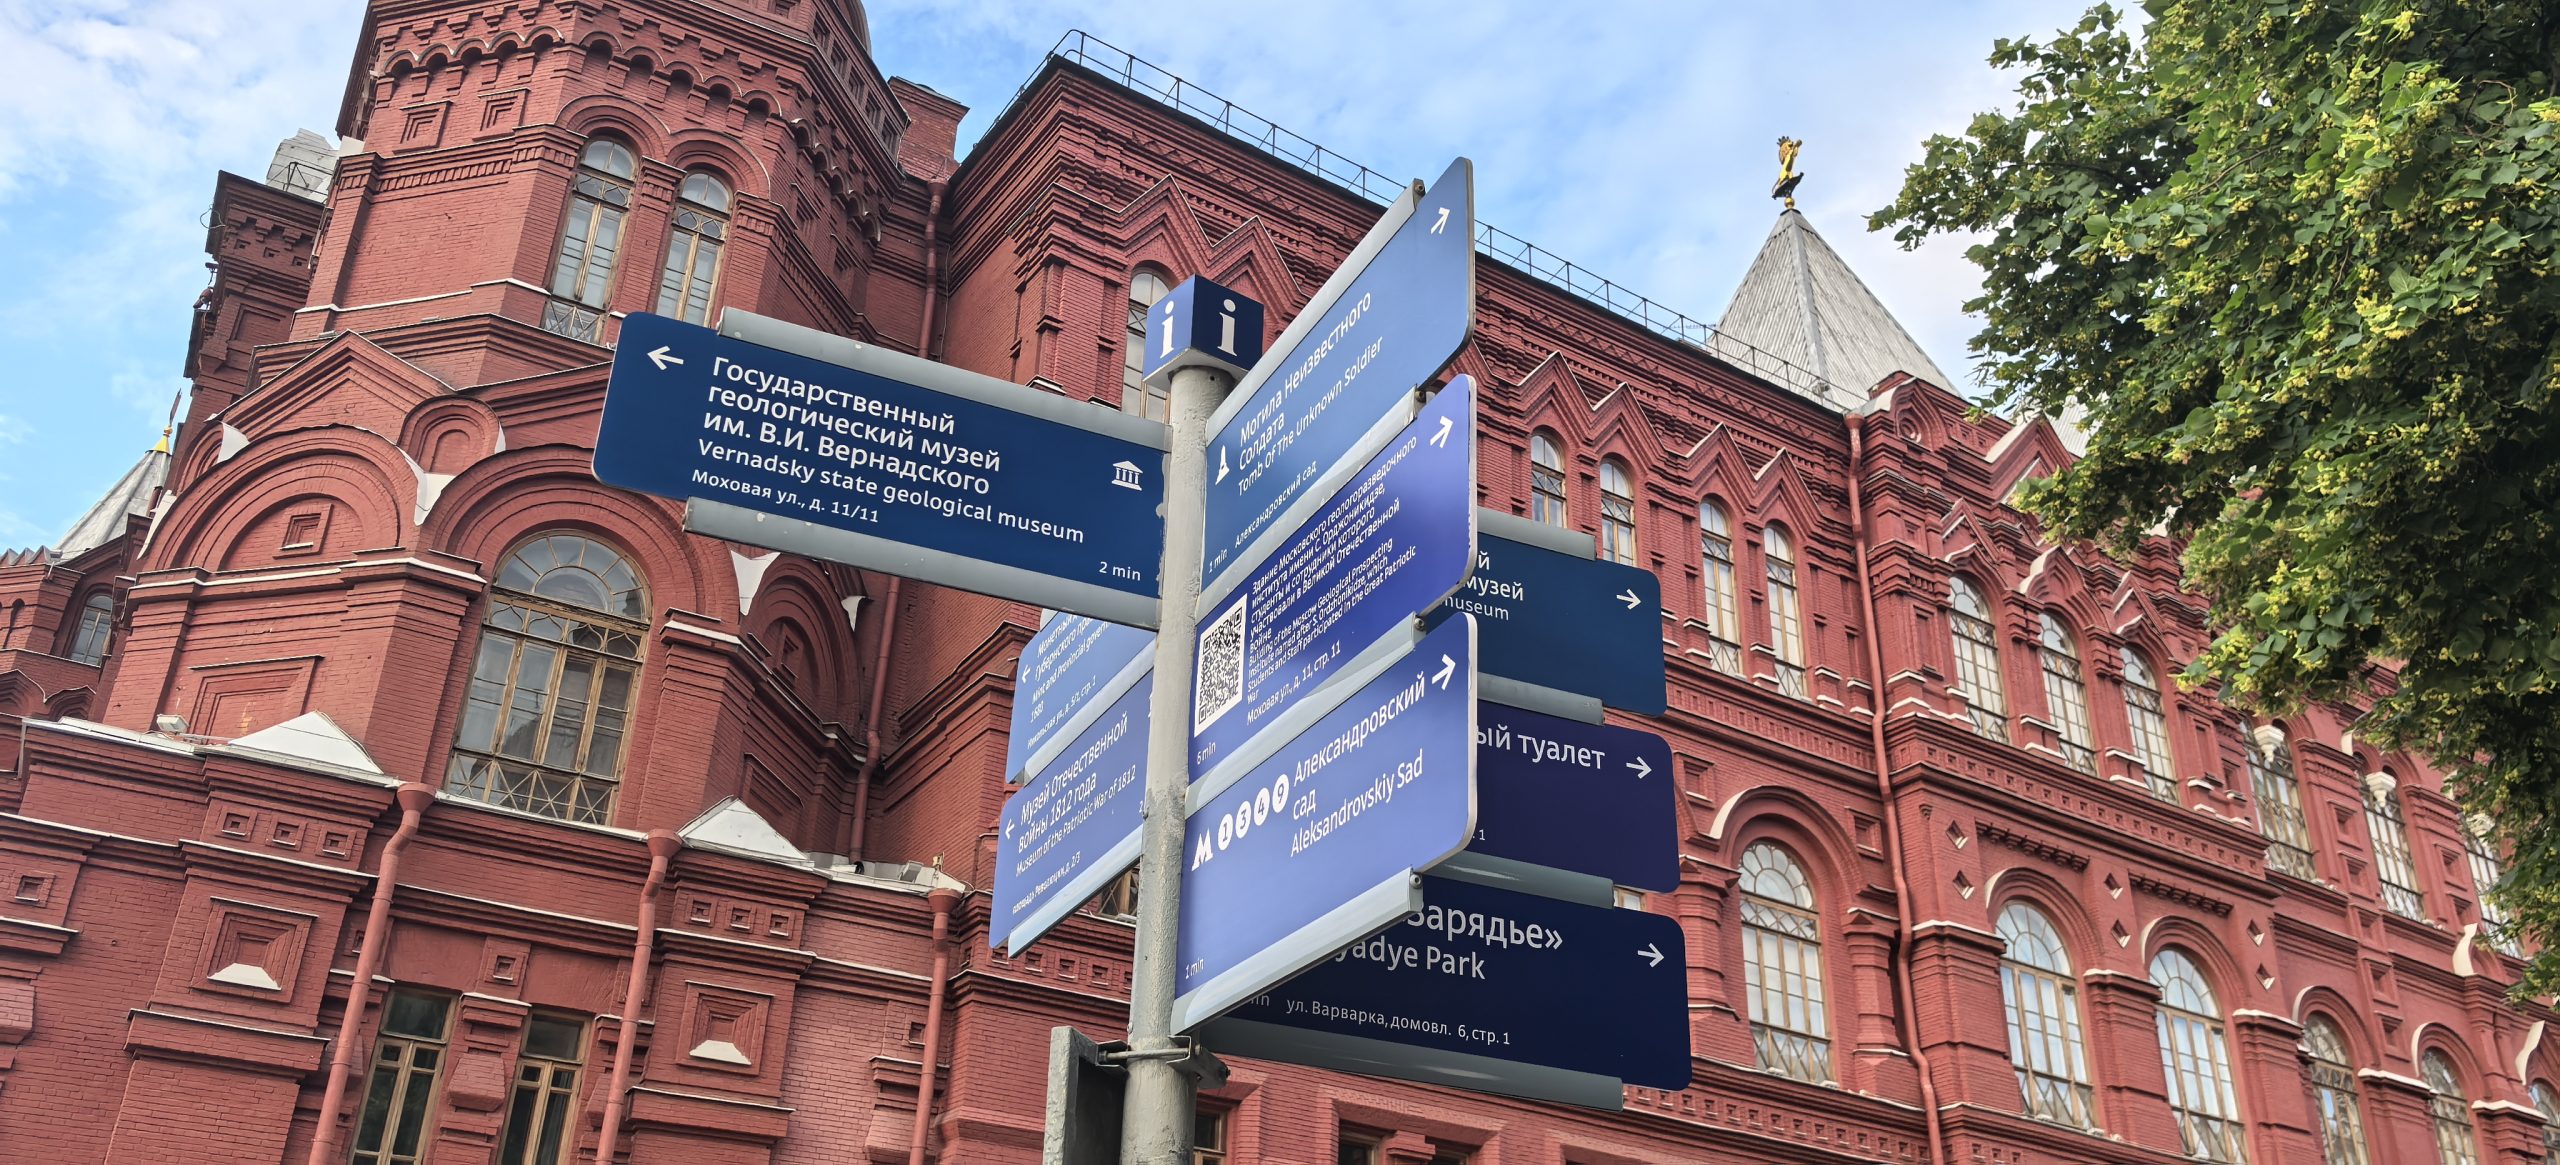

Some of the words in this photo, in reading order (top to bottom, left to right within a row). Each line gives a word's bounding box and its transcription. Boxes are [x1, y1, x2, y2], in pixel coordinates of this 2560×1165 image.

[713, 357, 955, 435] Государственный
[1240, 390, 1282, 447] Могила
[1285, 292, 1371, 399] Неизвестного
[703, 412, 751, 438] им.
[760, 422, 810, 452] В.И.
[818, 436, 990, 494] Вернадского
[708, 386, 914, 450] геологический
[921, 438, 1000, 472] музей
[1238, 462, 1263, 496] Tomb
[1265, 447, 1277, 468] Of
[1277, 431, 1294, 457] The
[1296, 380, 1342, 435] Unknown
[1344, 336, 1383, 386] Soldier
[1239, 412, 1285, 470] Солдата
[692, 469, 772, 499] Моховая
[776, 489, 806, 510] ул.,
[809, 499, 825, 512] д.
[831, 502, 879, 523] 11/11
[698, 438, 815, 484] Vernadsky
[820, 469, 878, 495] state
[883, 485, 992, 523] geological
[998, 511, 1084, 543] museum
[1235, 472, 1301, 548] Александровский
[1302, 461, 1317, 480] сад
[1252, 564, 1278, 595] Здание
[1278, 520, 1327, 570] Московского
[1327, 436, 1417, 526] геологоразведочного
[1099, 561, 1107, 574] 2
[1112, 566, 1141, 581] min
[1208, 560, 1213, 574] 1
[1214, 549, 1228, 568] min
[1250, 594, 1296, 642] участвовали
[1297, 590, 1301, 599] в
[1303, 556, 1335, 595] Великой
[1337, 497, 1400, 564] Отечественной
[1251, 588, 1284, 624] студенты
[1285, 583, 1291, 595] и
[1292, 545, 1336, 588] сотрудники
[1338, 507, 1375, 548] которого
[1252, 570, 1288, 609] института
[1289, 545, 1313, 578] имени
[1323, 483, 1385, 545] Орджоникидзе,
[1248, 662, 1275, 692] Students
[1274, 654, 1287, 671] and
[1303, 604, 1343, 650] participated
[1344, 601, 1350, 613] in
[1352, 591, 1364, 607] the
[1364, 573, 1383, 596] Great
[1384, 545, 1416, 580] Patriotic
[1249, 641, 1274, 668] Building
[1281, 624, 1292, 639] the
[1292, 603, 1317, 631] Moscow
[1318, 571, 1351, 608] Geological
[1352, 538, 1393, 584] Prospecting
[1250, 627, 1272, 654] войне
[1274, 631, 1296, 658] named
[1296, 620, 1312, 639] after
[1367, 555, 1388, 580] which
[1247, 691, 1280, 725] Моховая
[1314, 652, 1330, 671] стр.
[1331, 640, 1341, 658] 11
[1247, 689, 1259, 704] War
[1020, 781, 1050, 826] Музей
[1051, 710, 1128, 795] Отечественной
[1197, 750, 1202, 765] 6
[1202, 741, 1216, 761] min
[1294, 671, 1425, 787] Александровский
[1517, 734, 1605, 769] туалет
[1015, 845, 1043, 877] Museum
[1050, 829, 1063, 848] the
[1063, 802, 1093, 839] Patriotic
[1094, 794, 1109, 813] War
[1108, 784, 1118, 803] of
[1117, 764, 1136, 793] 1812
[1018, 815, 1049, 853] войны
[1050, 789, 1072, 828] 1812
[1074, 772, 1097, 806] года
[1290, 772, 1395, 857] Aleksandrovskiy
[1397, 748, 1423, 789] Sad
[1293, 789, 1316, 820] сад
[1185, 964, 1190, 980] 1
[1190, 957, 1204, 976] min
[1426, 945, 1485, 980] Park
[1286, 998, 1308, 1014] ул.
[1502, 1031, 1511, 1045] 1
